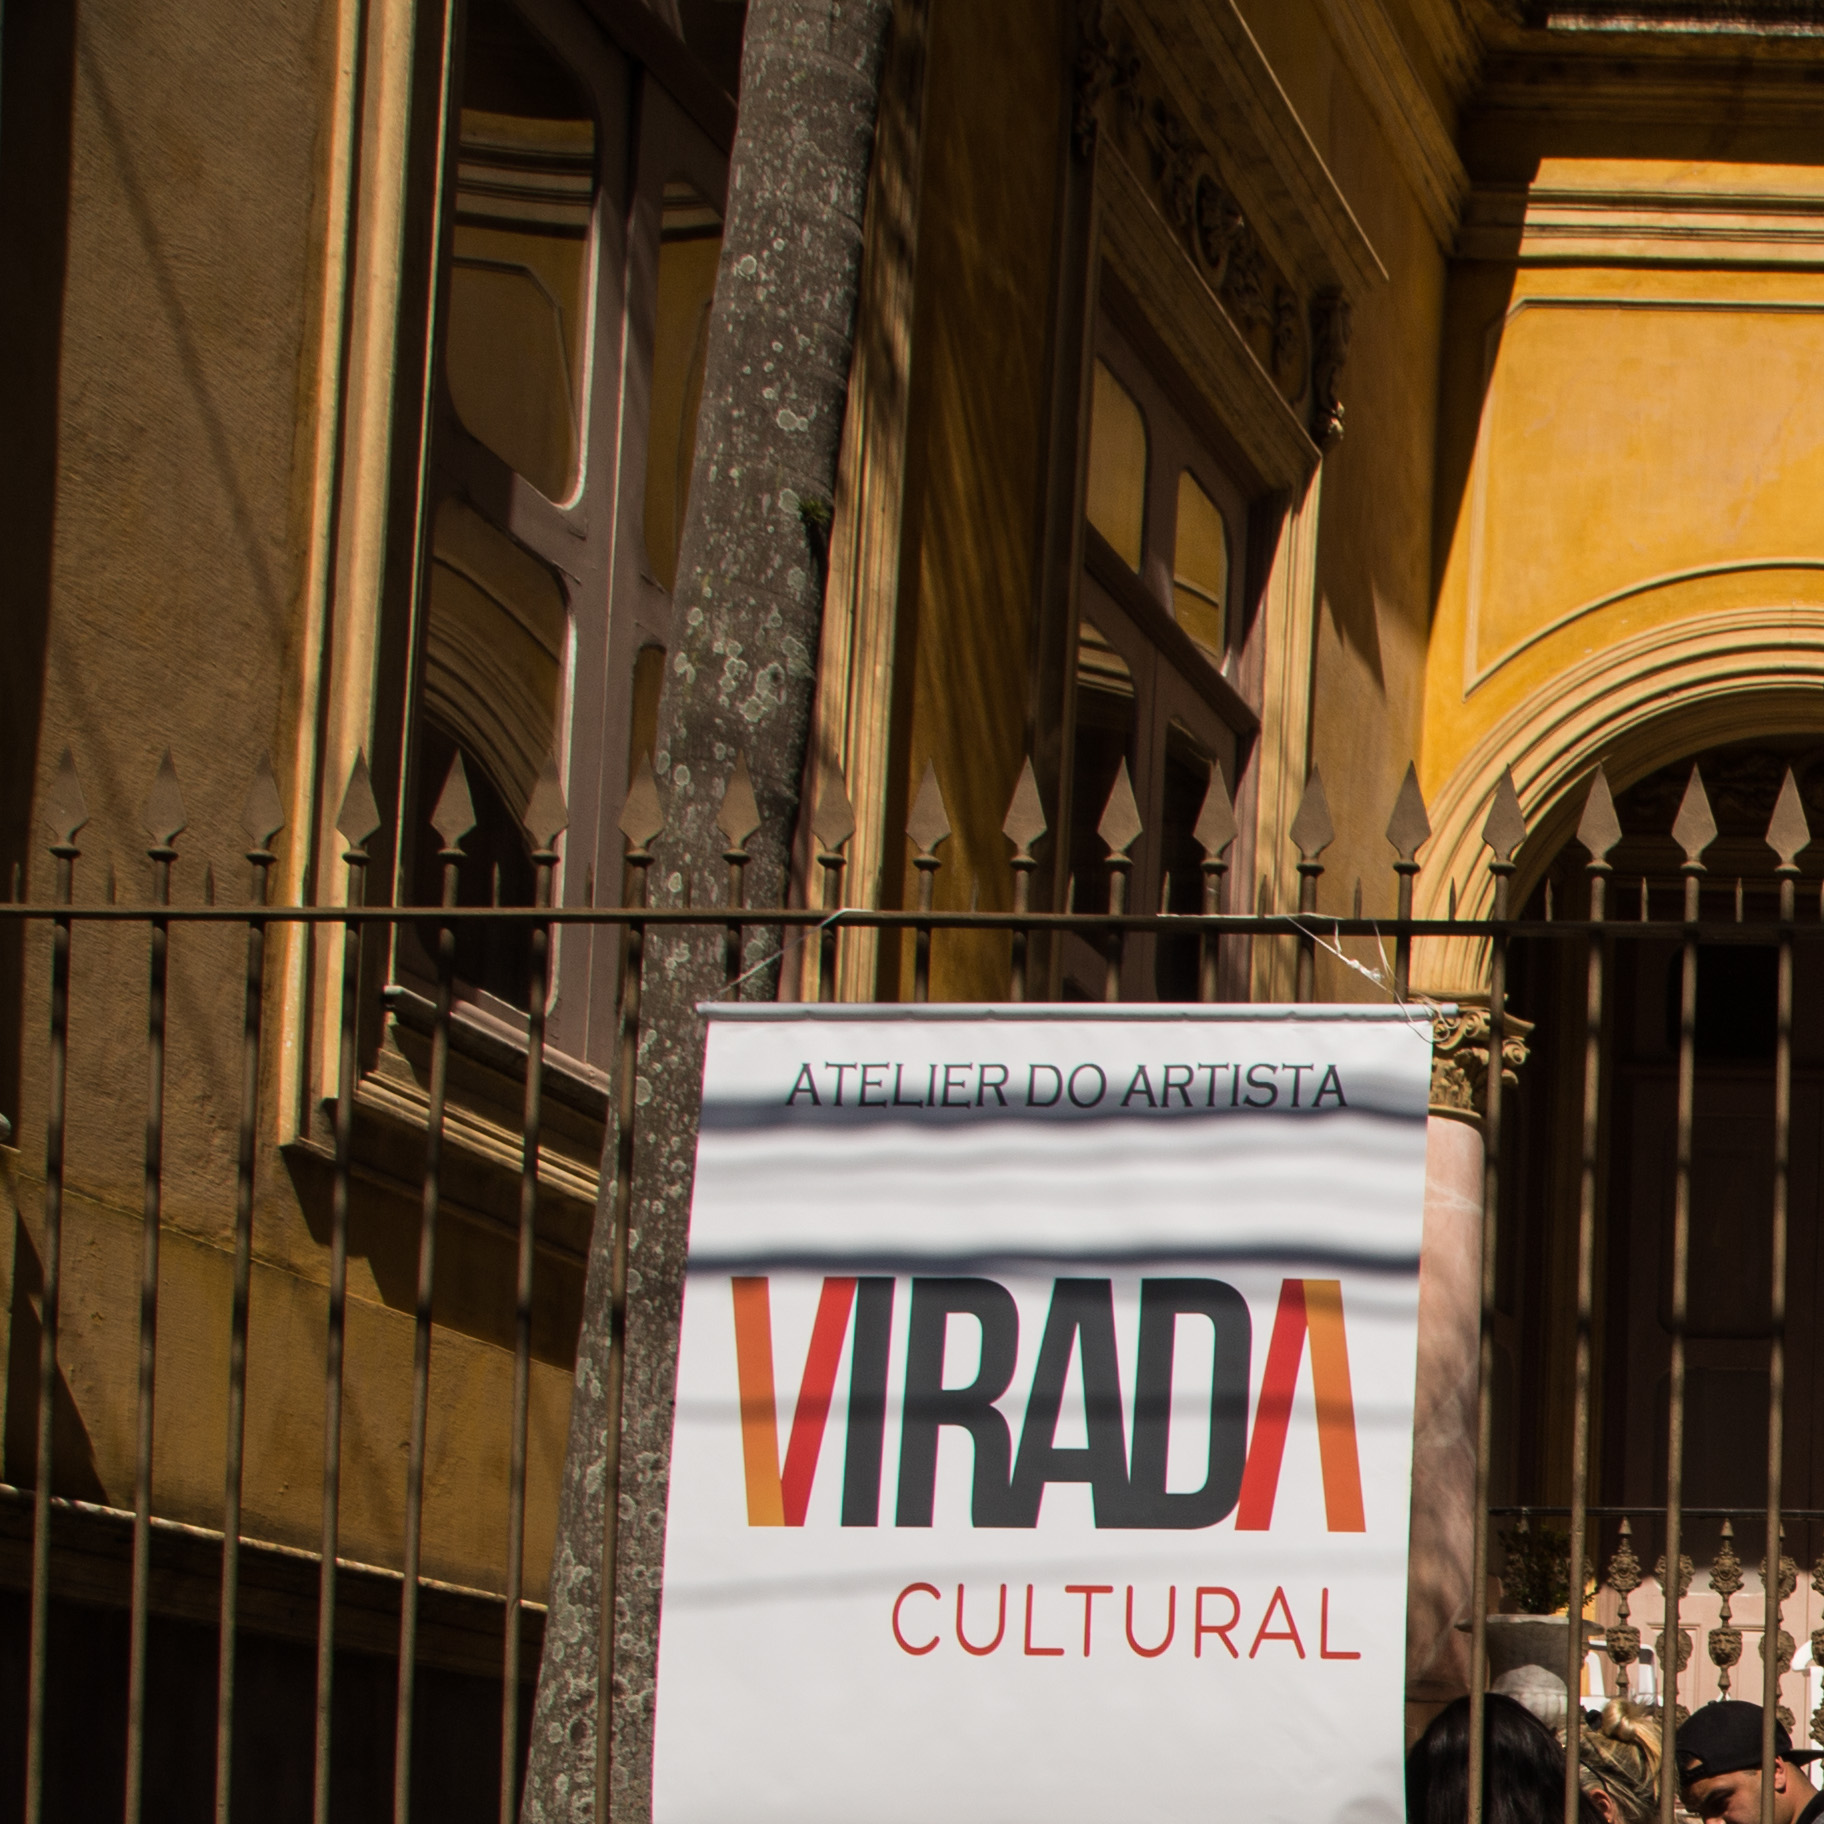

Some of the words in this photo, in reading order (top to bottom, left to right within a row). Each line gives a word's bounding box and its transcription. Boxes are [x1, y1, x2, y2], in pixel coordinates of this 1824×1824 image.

[785, 1061, 1011, 1110] ATELIER
[1025, 1062, 1108, 1109] DO
[1119, 1062, 1349, 1109] ARTISTA
[731, 1275, 1368, 1534] VIRADA
[891, 1582, 1362, 1661] CULTURAL
